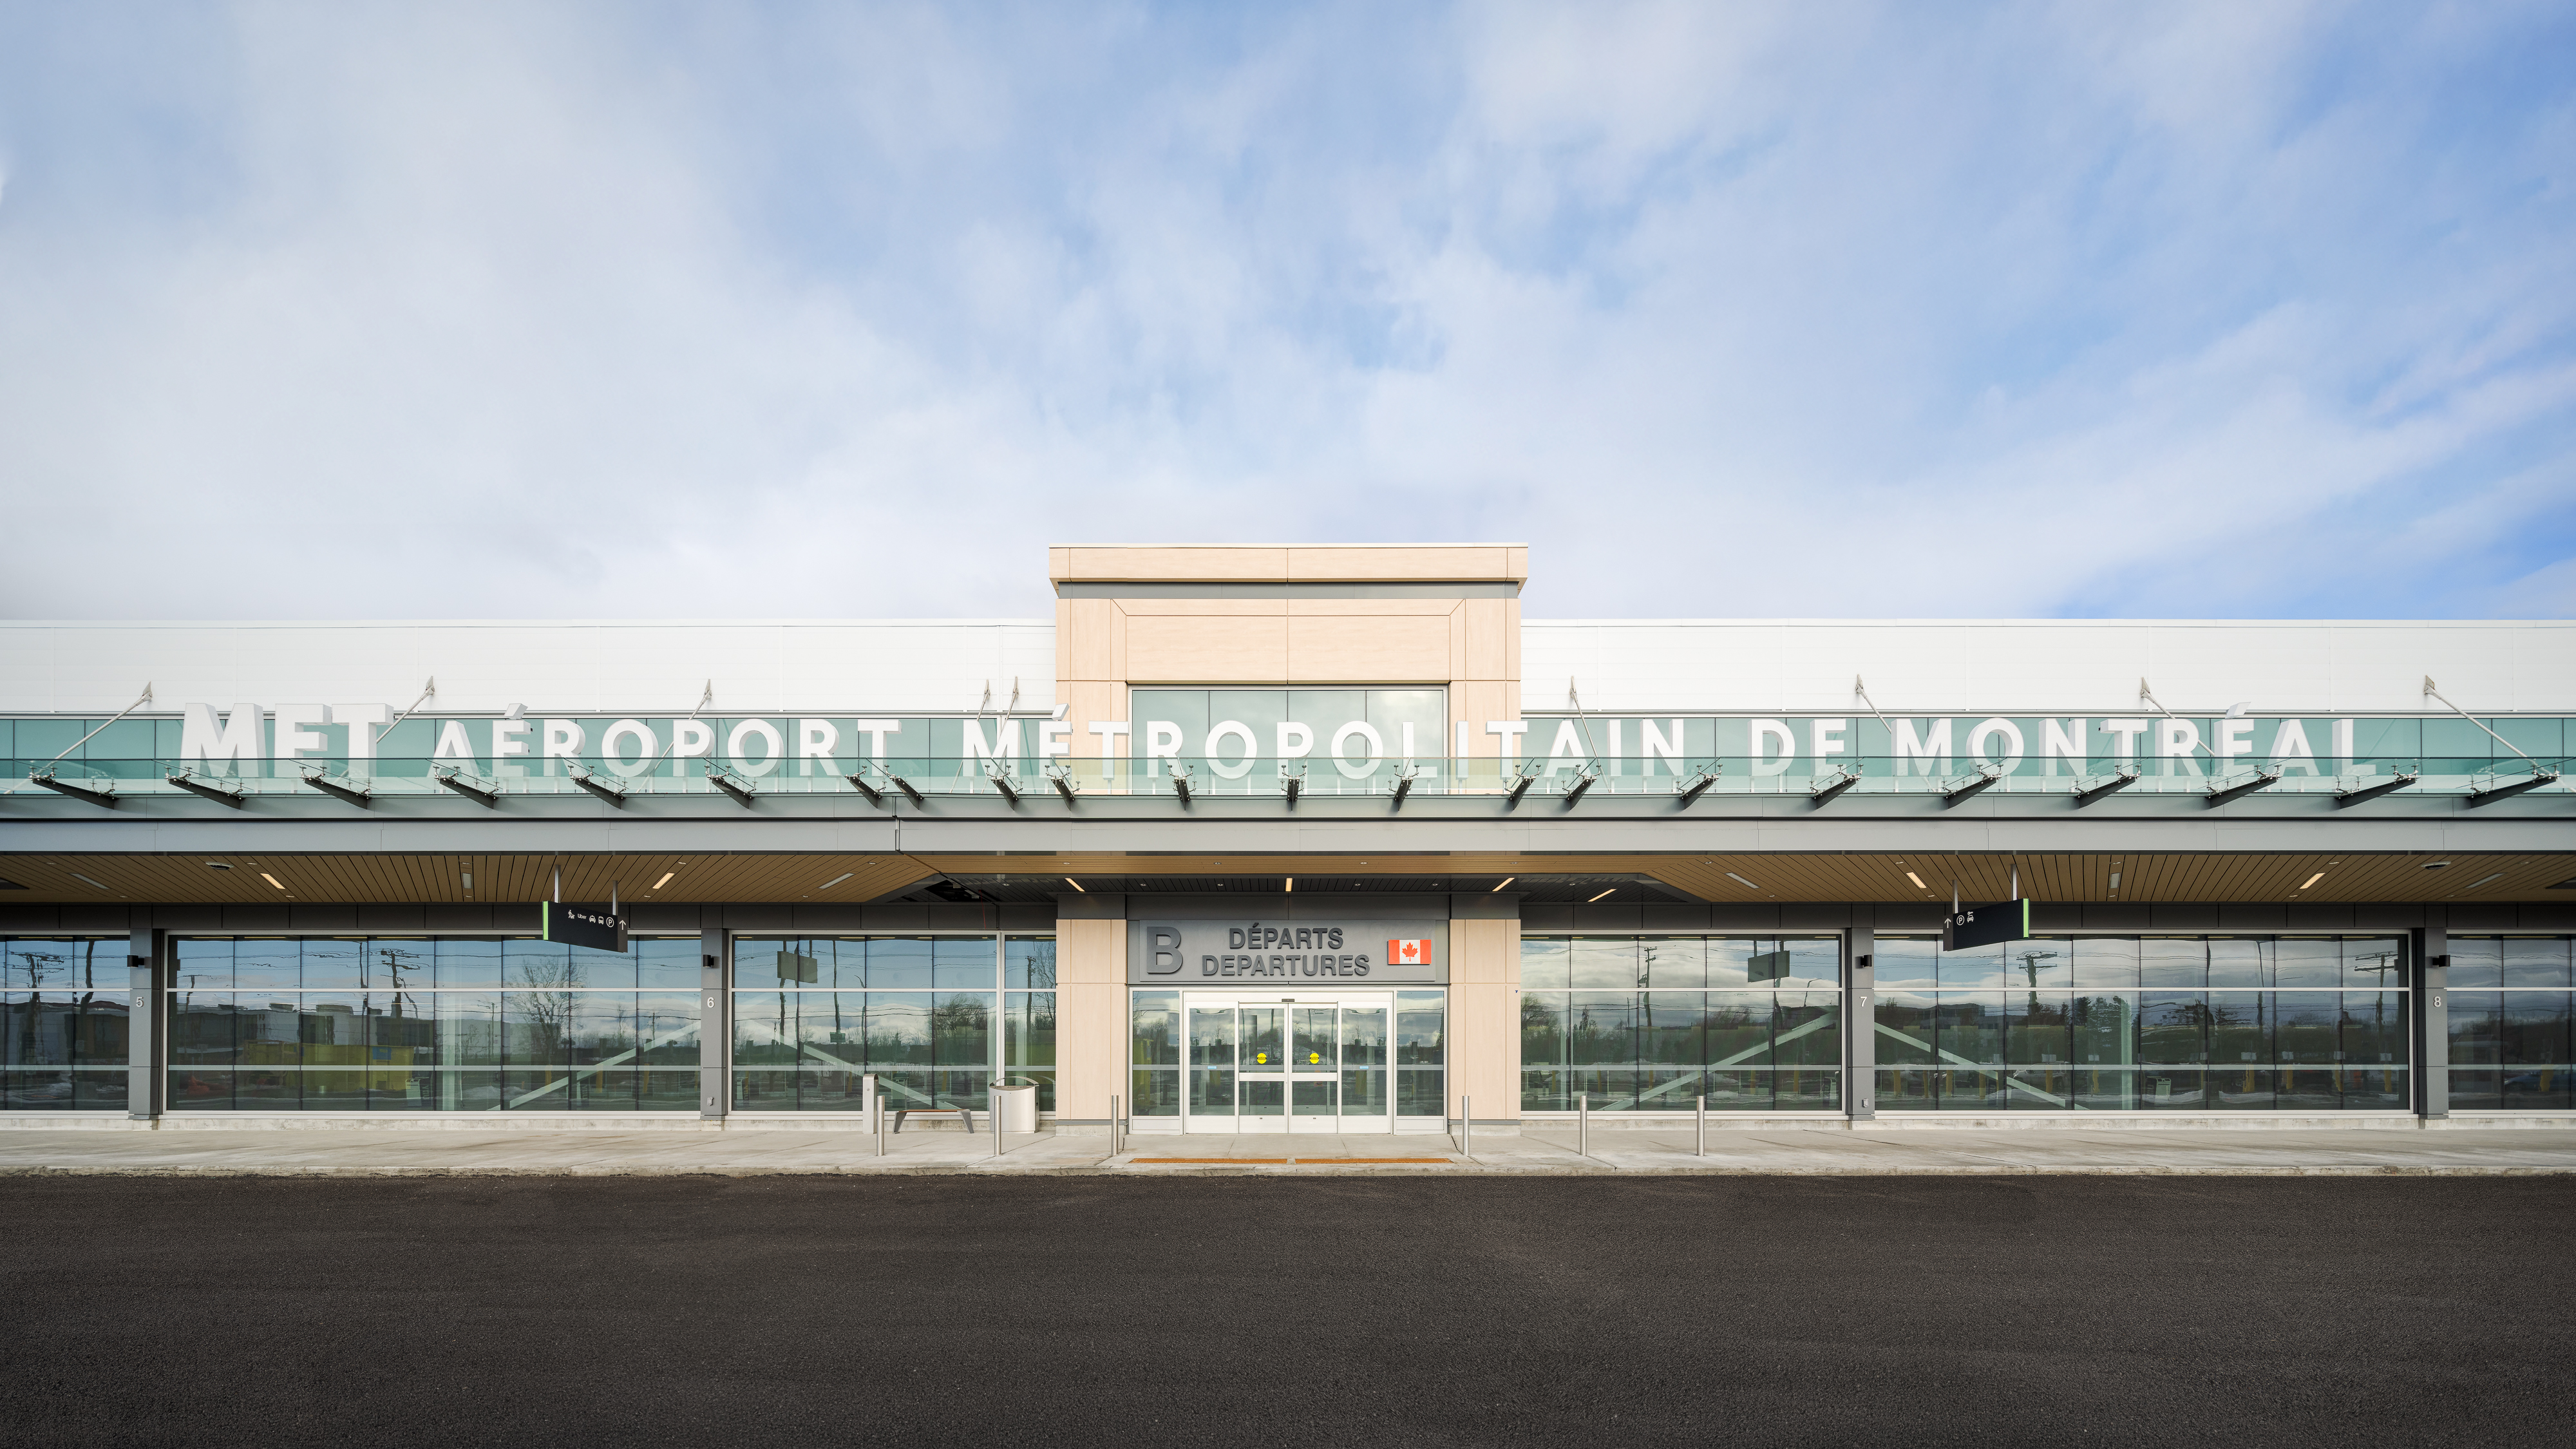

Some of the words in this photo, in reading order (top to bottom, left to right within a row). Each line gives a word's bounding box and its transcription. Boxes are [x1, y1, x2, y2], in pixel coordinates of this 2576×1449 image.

[180, 703, 393, 779] MET
[427, 703, 902, 779] AÉROPORT
[962, 703, 1684, 781] MÉTROPOLITAIN
[1747, 718, 1847, 777] DE
[1890, 701, 2376, 778] MONTRÉAL
[1229, 922, 1344, 950] DÉPARTS
[1146, 926, 1183, 974] B
[1202, 954, 1371, 976] DEPARTURES
[136, 996, 144, 1008] 5
[707, 997, 715, 1009] 6
[1860, 996, 1868, 1007] 7
[2434, 996, 2441, 1007] 8
